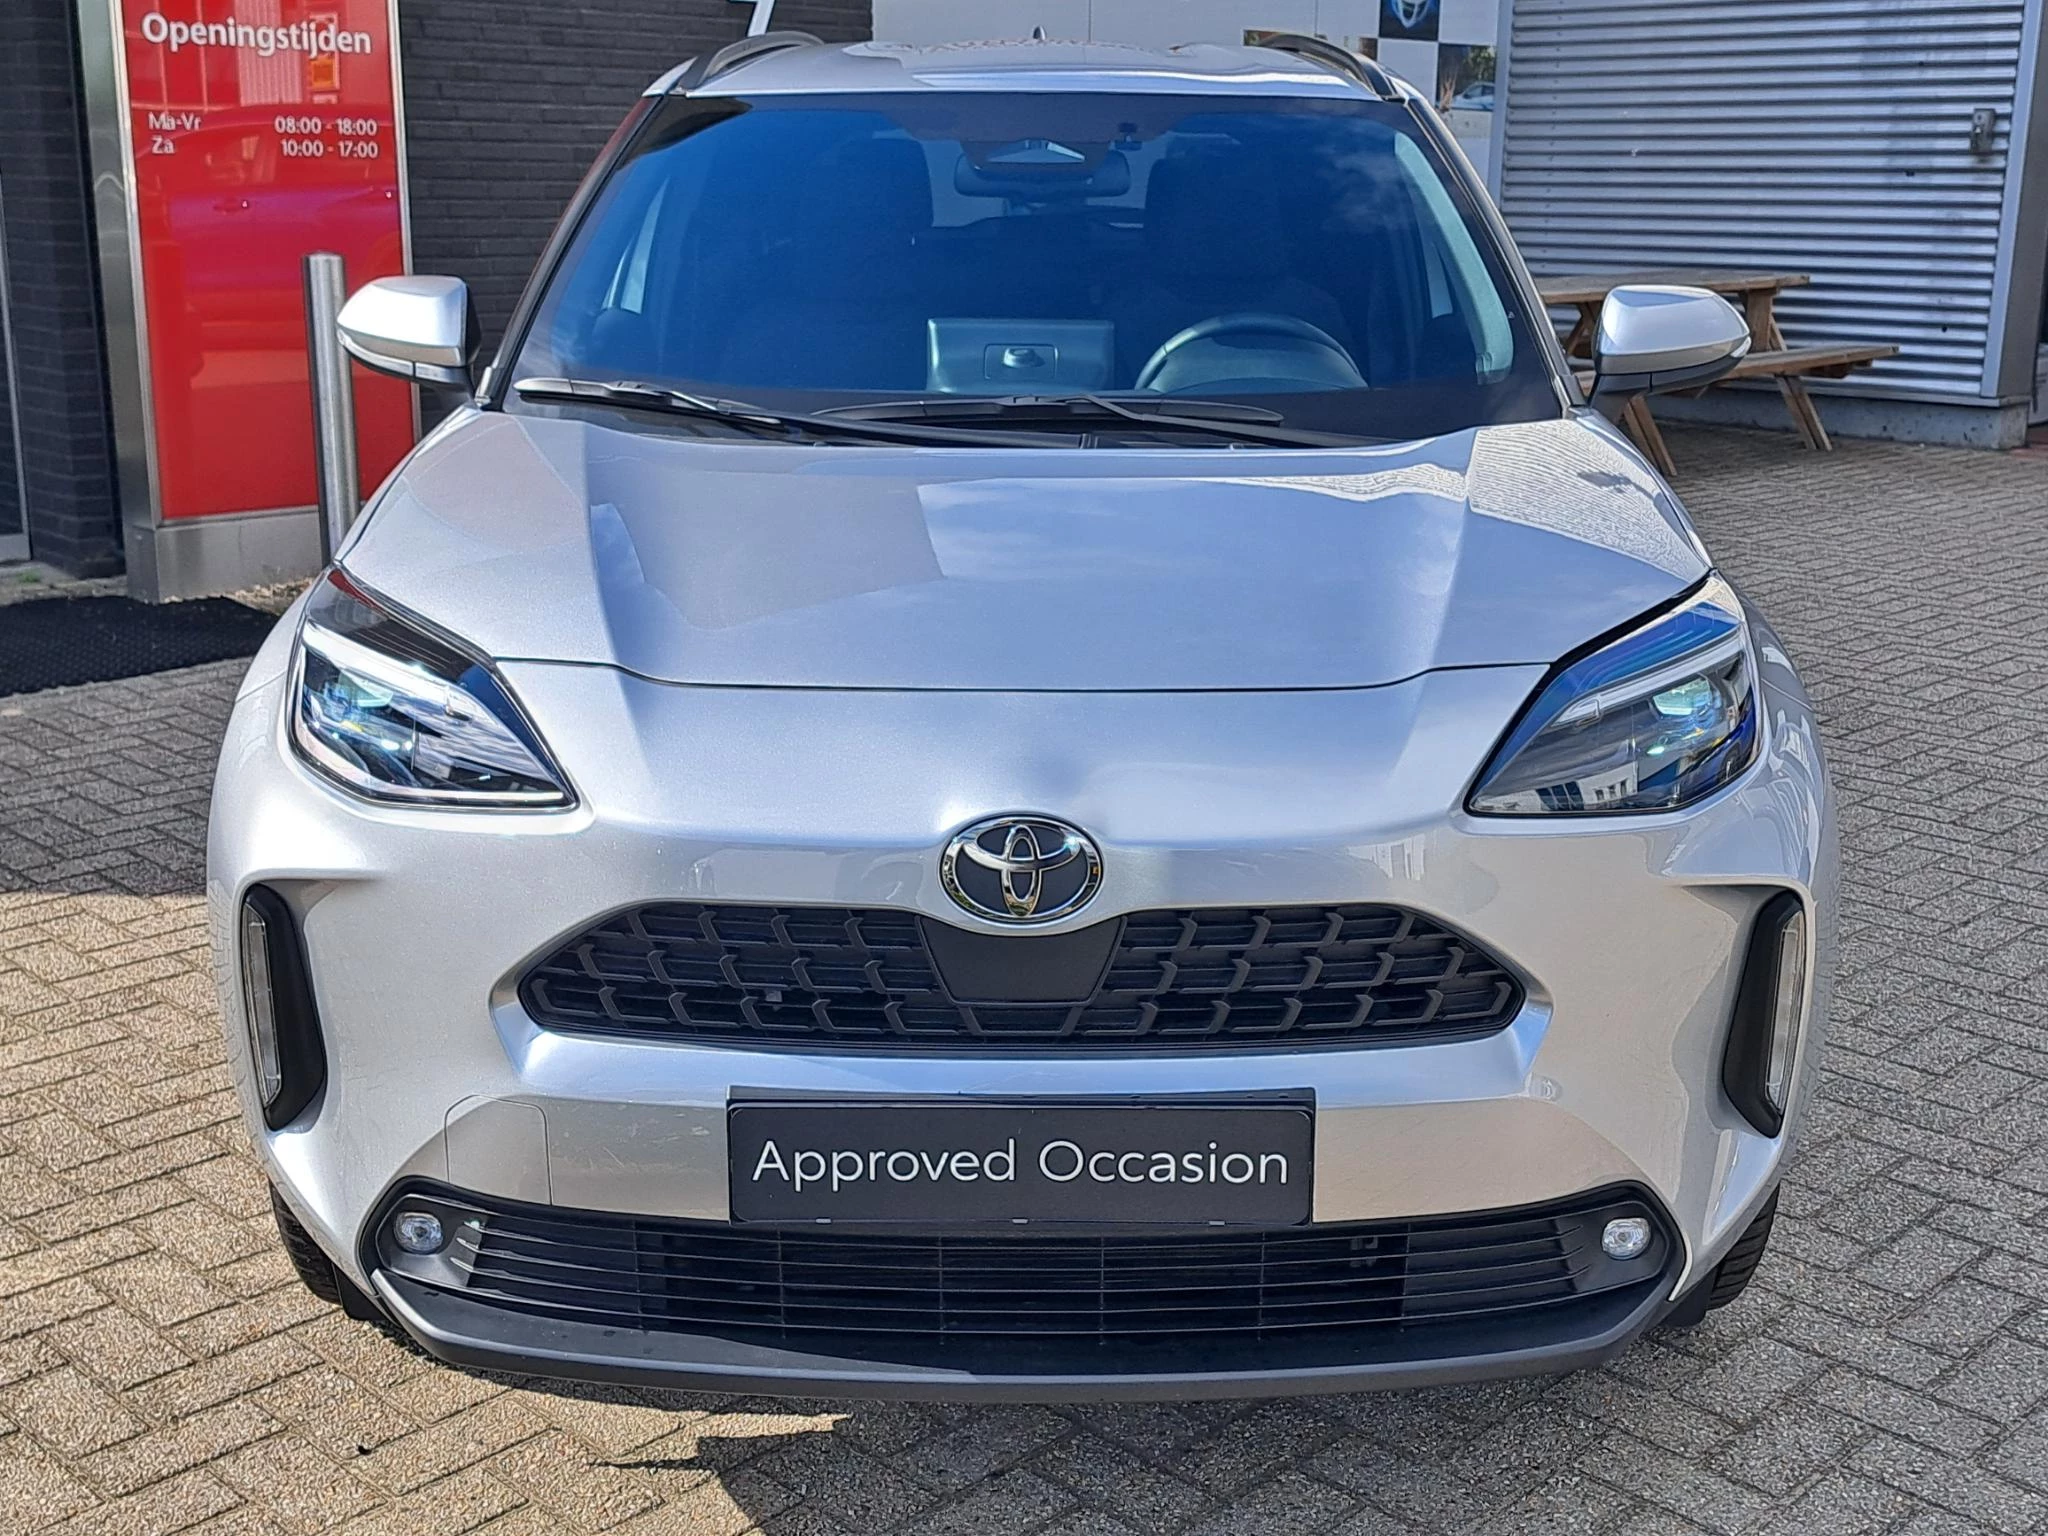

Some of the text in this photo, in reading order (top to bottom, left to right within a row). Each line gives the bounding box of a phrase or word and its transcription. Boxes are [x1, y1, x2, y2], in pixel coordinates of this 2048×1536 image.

[141, 14, 372, 57] Openingstijden
[148, 111, 201, 131] Ma-Vr
[274, 115, 322, 134] 08:00
[336, 117, 378, 136] 18:00
[151, 135, 175, 155] Za
[281, 138, 324, 157] 10:00
[338, 140, 379, 159] 17:00
[752, 1138, 1290, 1192] Approved Occasion
